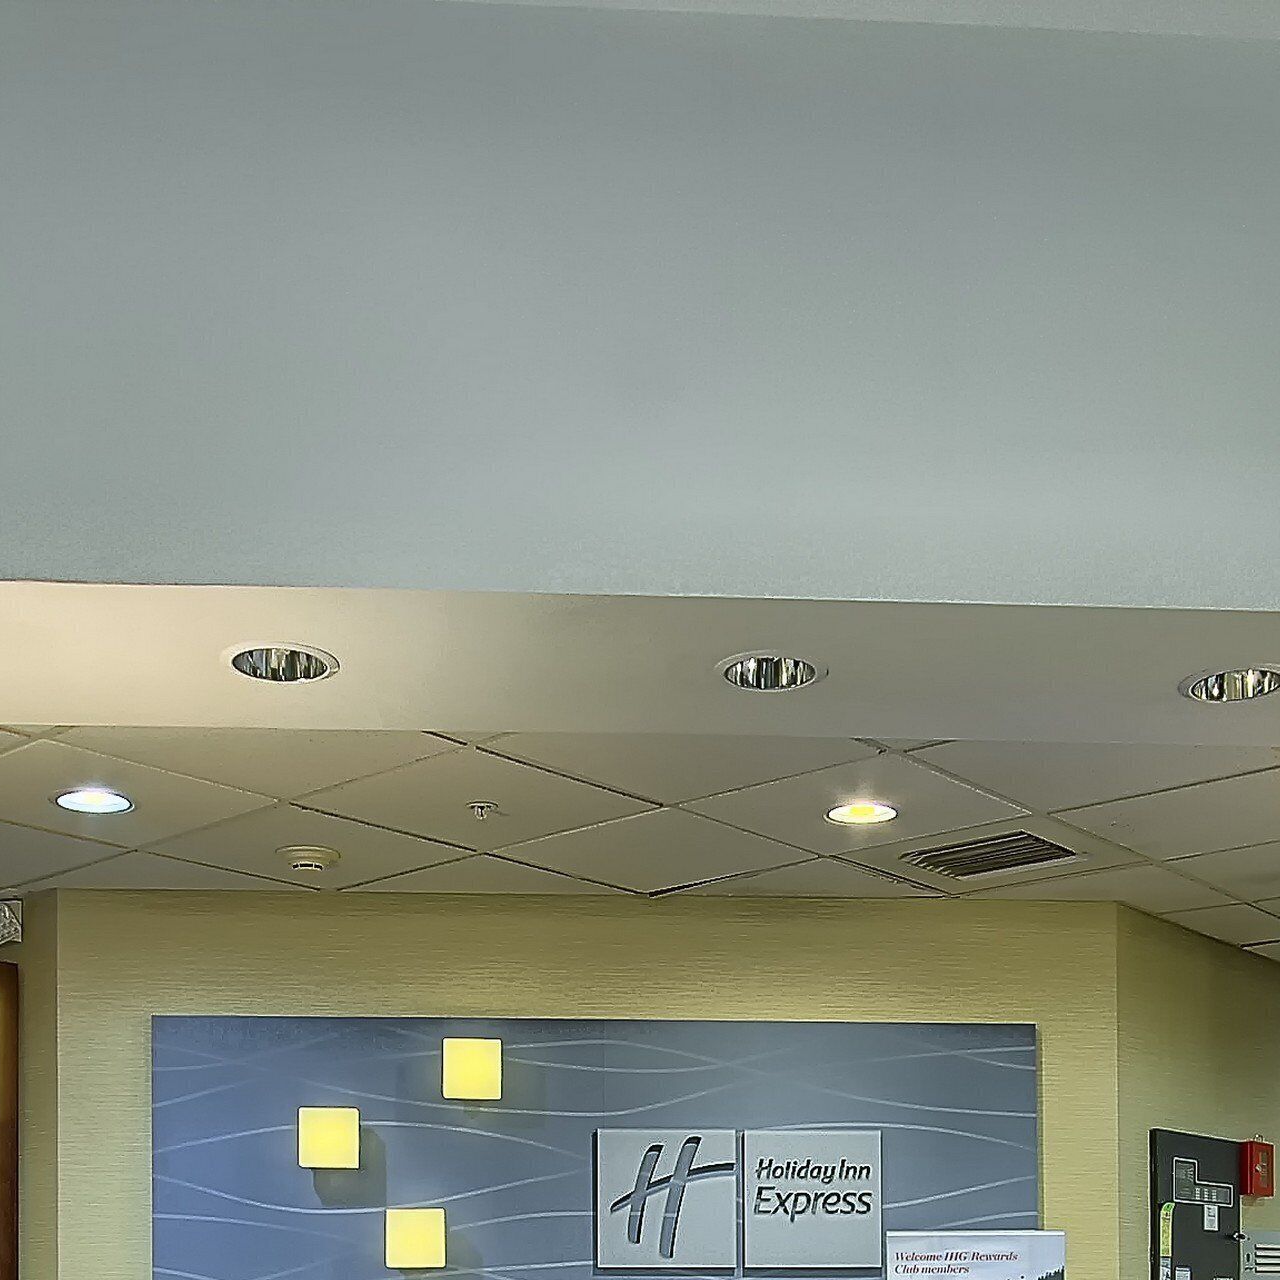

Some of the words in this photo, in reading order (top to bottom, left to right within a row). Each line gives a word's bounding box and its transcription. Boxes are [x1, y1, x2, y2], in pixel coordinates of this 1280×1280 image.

[756, 1159, 836, 1184] Holiday
[839, 1159, 871, 1180] Inn
[754, 1186, 873, 1223] Express
[895, 1252, 942, 1261] Welcome
[944, 1251, 969, 1261] IHG
[971, 1251, 1019, 1261] Rewards
[895, 1264, 919, 1274] Club
[921, 1264, 970, 1274] members
